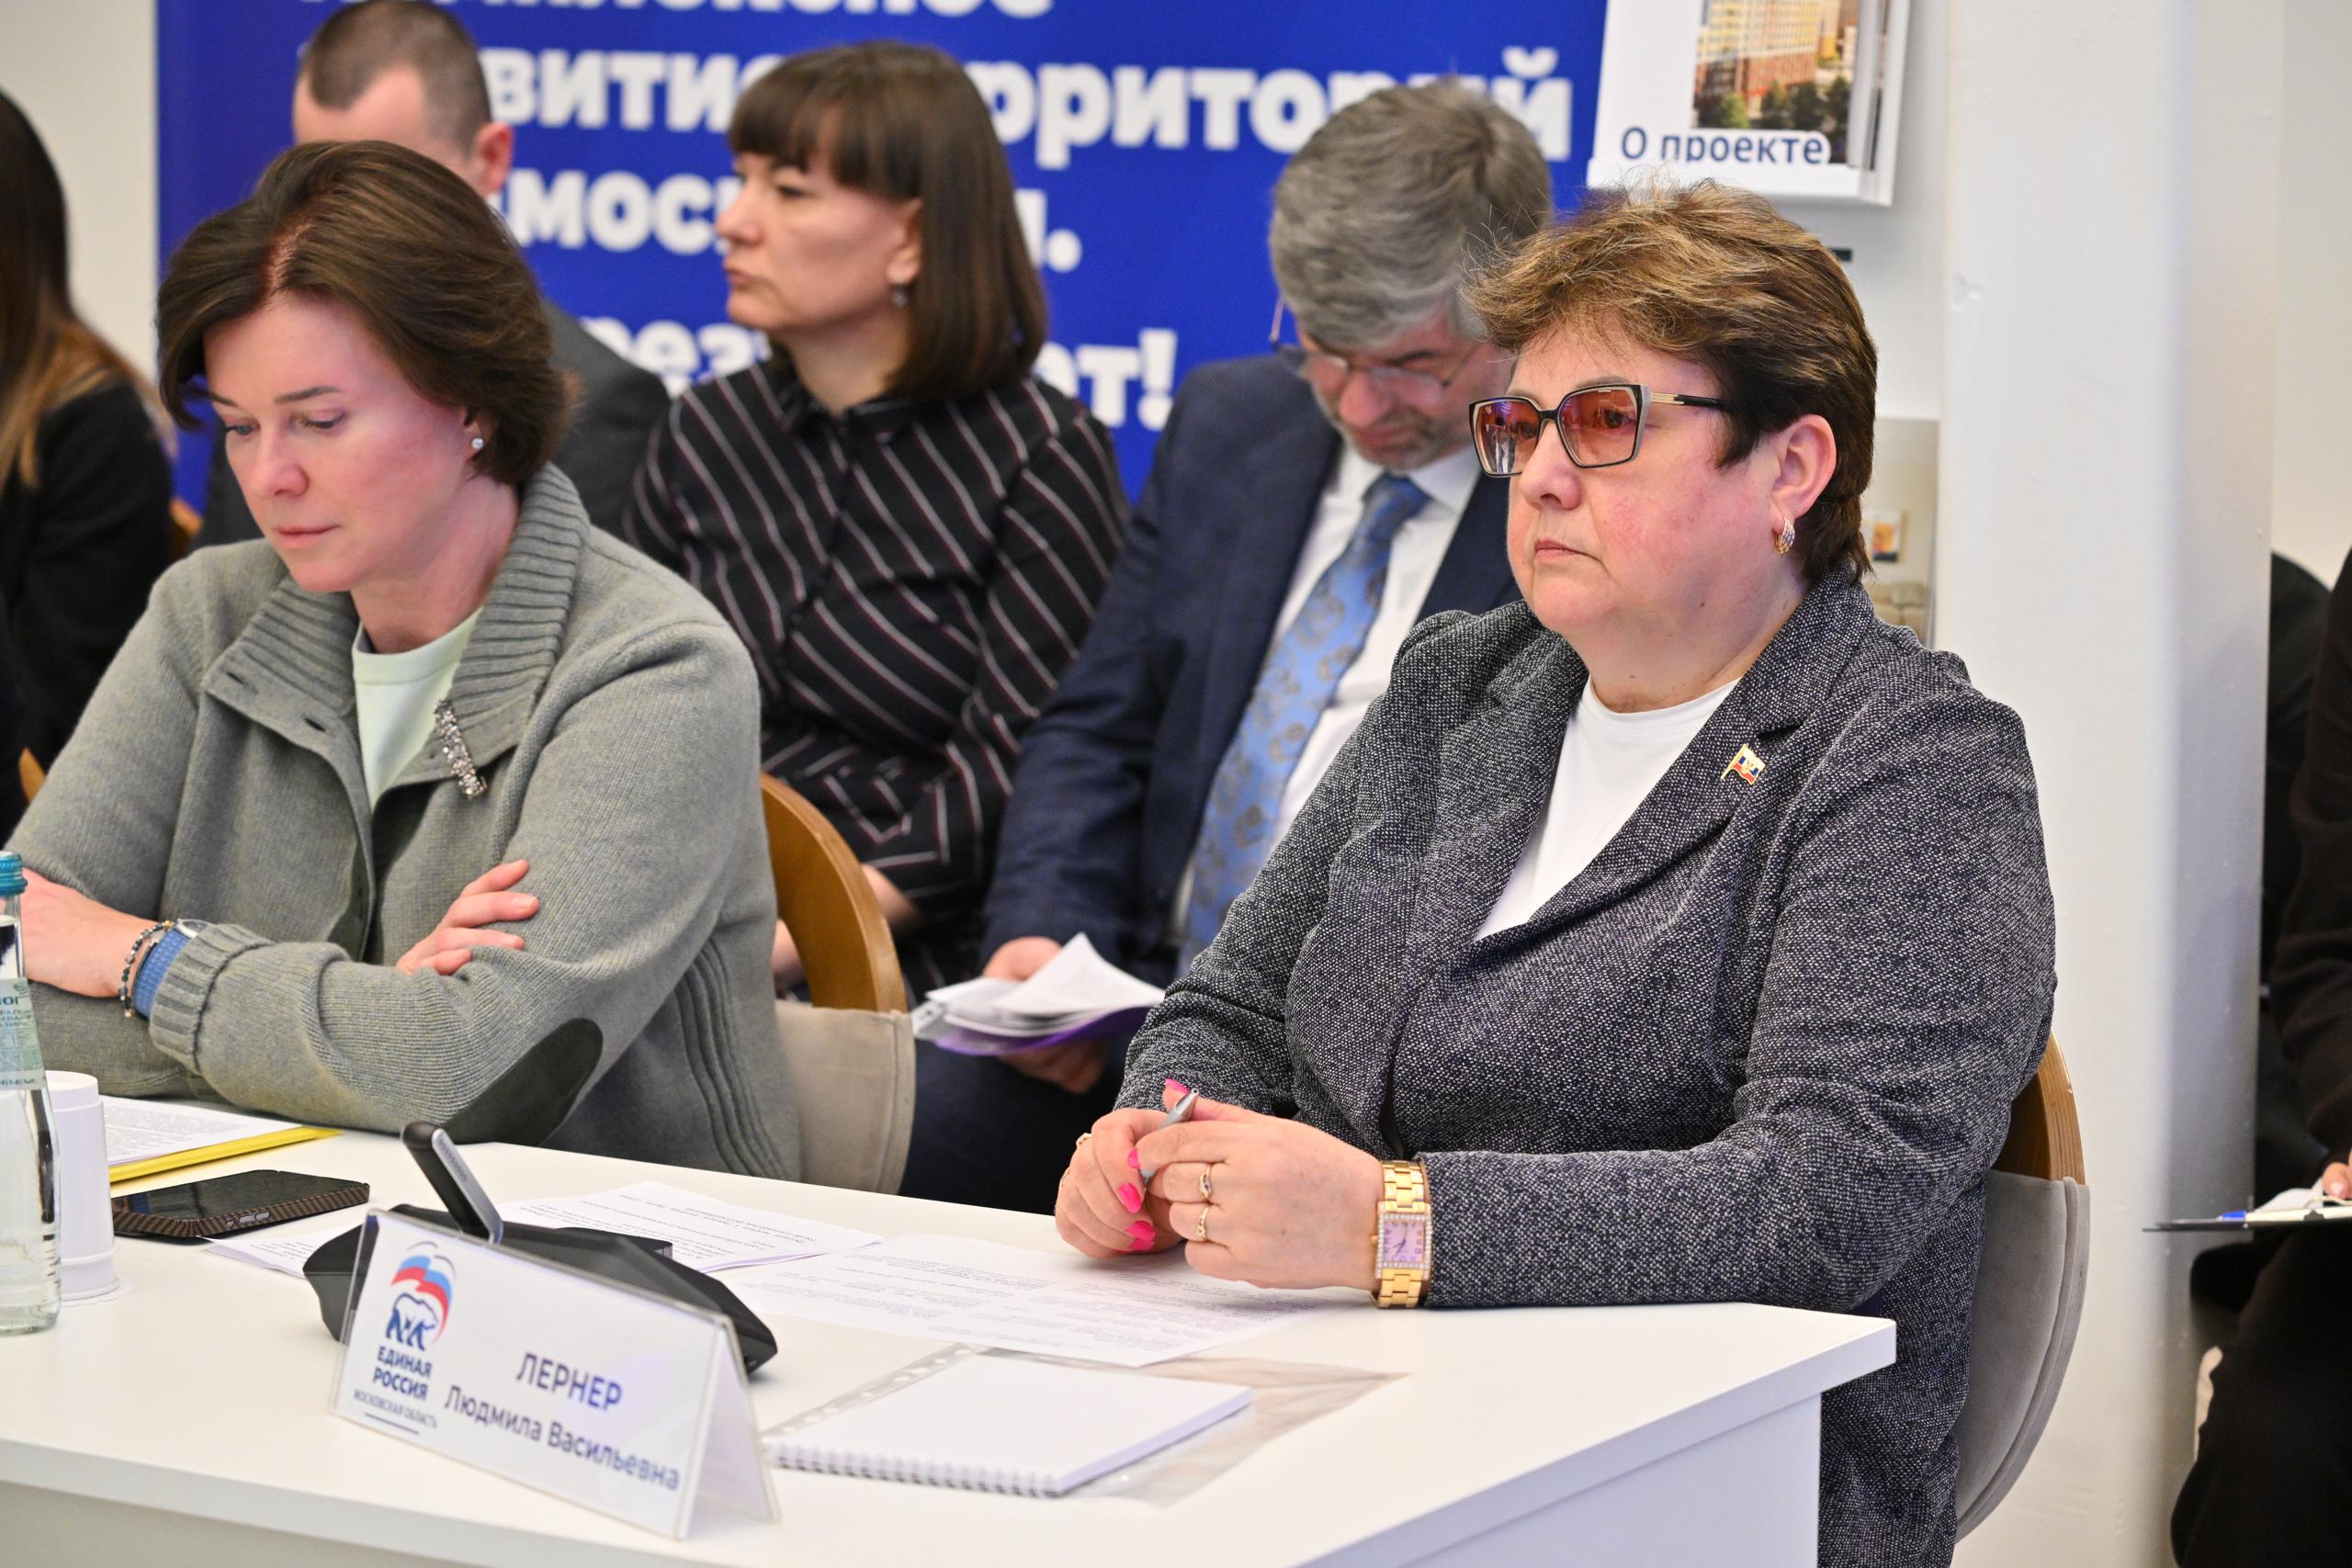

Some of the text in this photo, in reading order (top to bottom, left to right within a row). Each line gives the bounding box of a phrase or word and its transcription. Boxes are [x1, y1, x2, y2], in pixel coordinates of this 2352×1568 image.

[1621, 126, 1824, 164] О проекте
[377, 1345, 432, 1379] ЕДИНАЯ
[516, 1351, 623, 1411] ЛЕРНЕР
[372, 1366, 428, 1402] РОССИЯ
[445, 1384, 680, 1492] Людмила Васильевна
